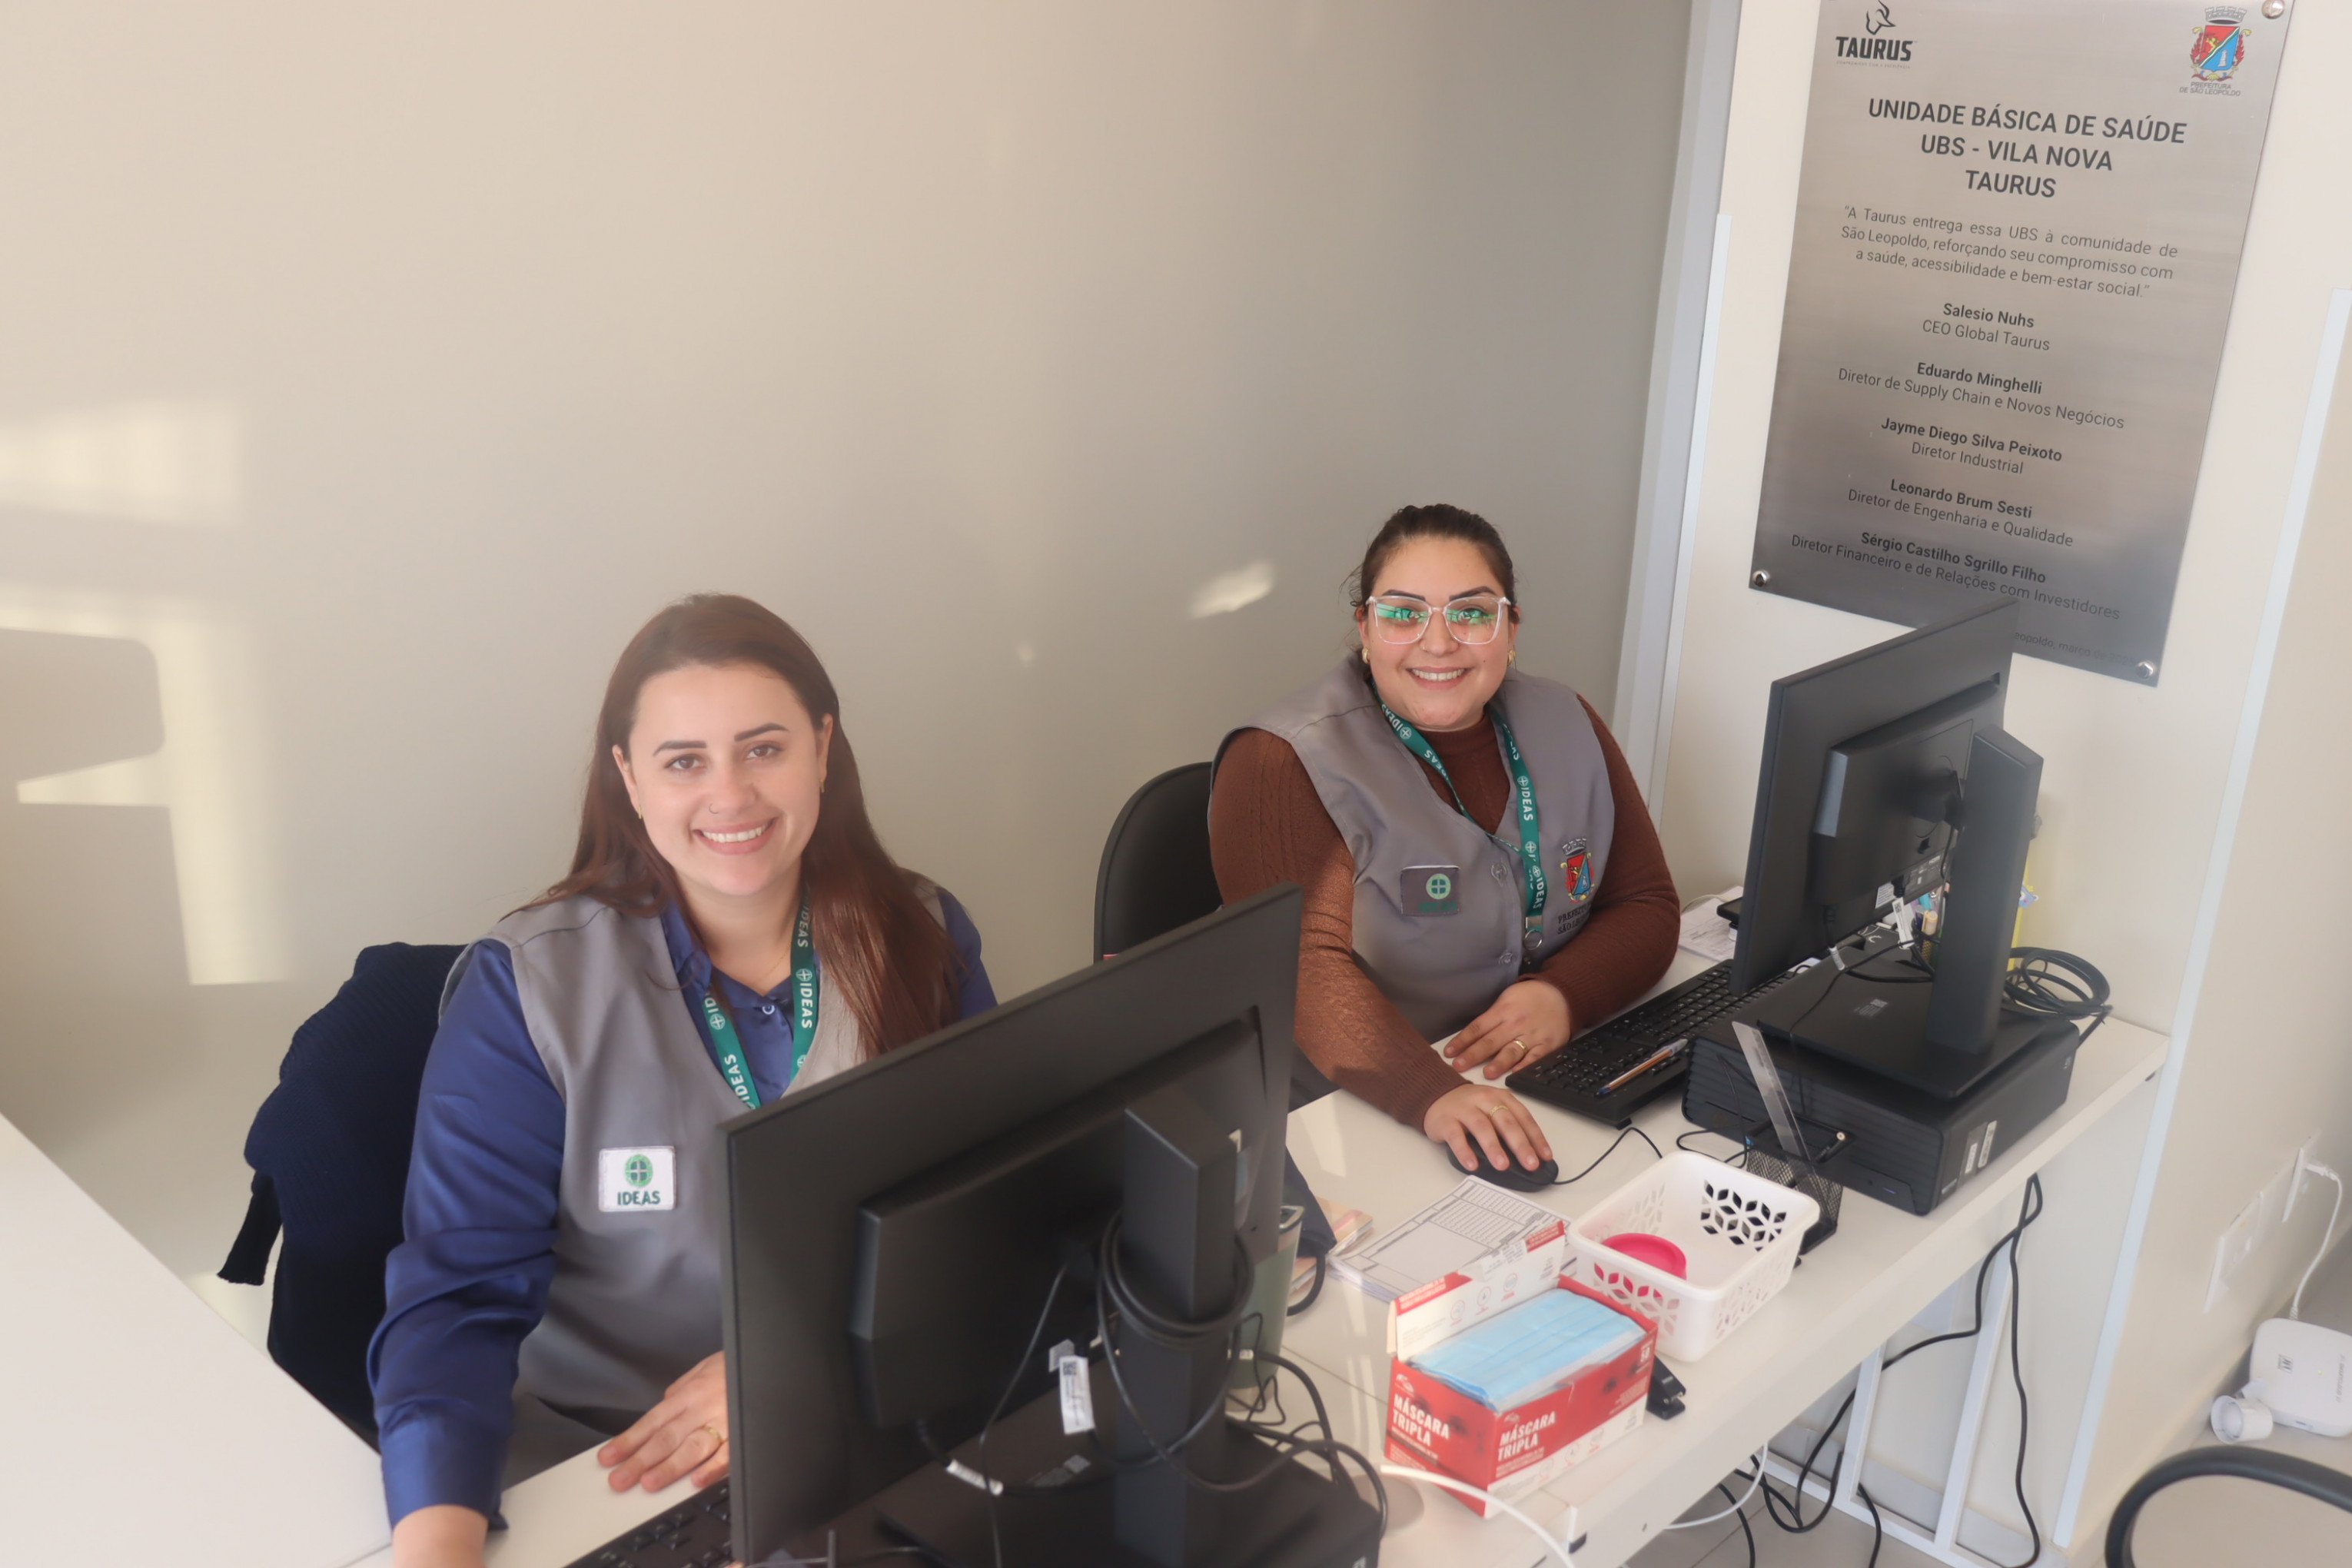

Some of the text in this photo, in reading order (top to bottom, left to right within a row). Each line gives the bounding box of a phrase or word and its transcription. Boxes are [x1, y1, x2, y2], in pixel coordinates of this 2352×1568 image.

[1835, 36, 1913, 61] TAURUS
[2190, 81, 2231, 90] PREFEITURA
[2204, 88, 2241, 97] LEOPOLDO
[1869, 98, 2188, 144] UNIDADE BÁSICA DE SAÚDE
[1921, 134, 1965, 157] UBS
[1988, 140, 2038, 164] VILA
[2045, 145, 2112, 171] NOVA
[1965, 170, 2056, 198] TAURUS
[1864, 208, 1906, 225] Taurus
[1912, 217, 1963, 234] entrega
[1970, 224, 2002, 237] essa
[2009, 225, 2038, 241] UBS
[2061, 234, 2151, 254] comunidade
[2159, 243, 2178, 258] de
[1841, 225, 2173, 280] São Leopoldo, reforçando seu compromisso com
[1855, 250, 1864, 260] a
[1867, 251, 1908, 268] saúde,
[1912, 257, 2006, 279] acessibilidade
[2010, 271, 2018, 281] e
[2021, 268, 2093, 291] bem-estar
[1942, 302, 2035, 328] Salesio Nuhs
[1922, 319, 2050, 351] CEO Global Taurus
[1917, 362, 2042, 394] Eduardo Minghelli
[1839, 367, 2124, 429] Diretor de Supply Chain e Novos Negócios
[1881, 417, 2062, 462] Jayme Diego Silva Peixoto
[1912, 441, 2024, 474] Diretor Industrial
[1848, 488, 2073, 546] Diretor de Engenharia e Qualidade
[1890, 478, 2033, 519] Leonardo Brum Sesti
[1861, 532, 2046, 583] Sérgio Castilho Sgrillo Filho
[1792, 534, 2121, 620] Diretor Financeiro e de Relações com Investidores
[2014, 631, 2056, 649] eopoldo,
[1520, 786, 1534, 822] IDEAS
[1533, 876, 1545, 909] IDEAS
[797, 905, 810, 948] IDEAS
[799, 982, 813, 1029] IDEAS
[724, 1053, 750, 1101] IDEAS
[616, 1190, 661, 1206] IDEAS
[1392, 1408, 1432, 1447] TRIPLA
[1394, 1393, 1450, 1440] MÁSCARA
[1500, 1410, 1556, 1447] MÁSCARA
[1497, 1433, 1539, 1462] TRIPLA
